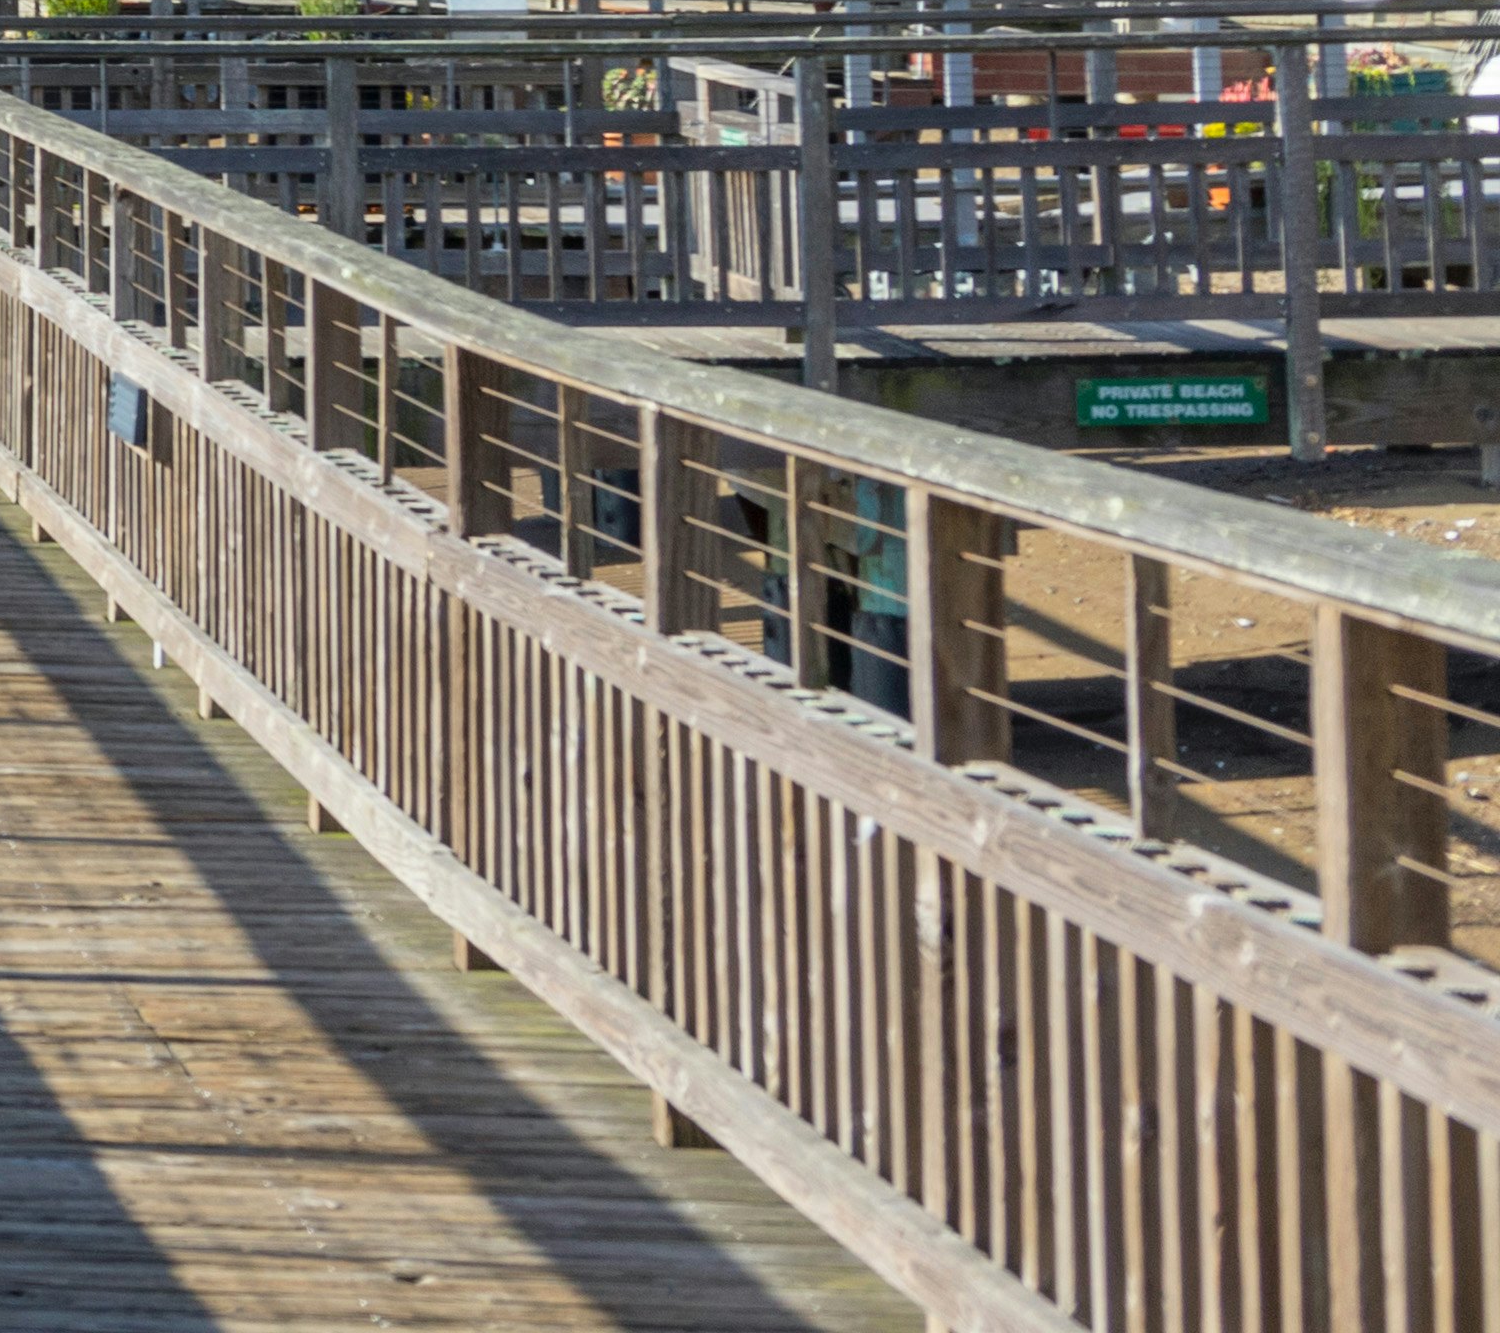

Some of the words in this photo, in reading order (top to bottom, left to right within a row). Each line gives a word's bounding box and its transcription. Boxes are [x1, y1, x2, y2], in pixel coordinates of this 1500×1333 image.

[1099, 385, 1173, 399] PRIVATE
[1179, 384, 1244, 399] BEACH
[1091, 405, 1119, 419] NO
[1125, 403, 1254, 418] TRESPASSING
